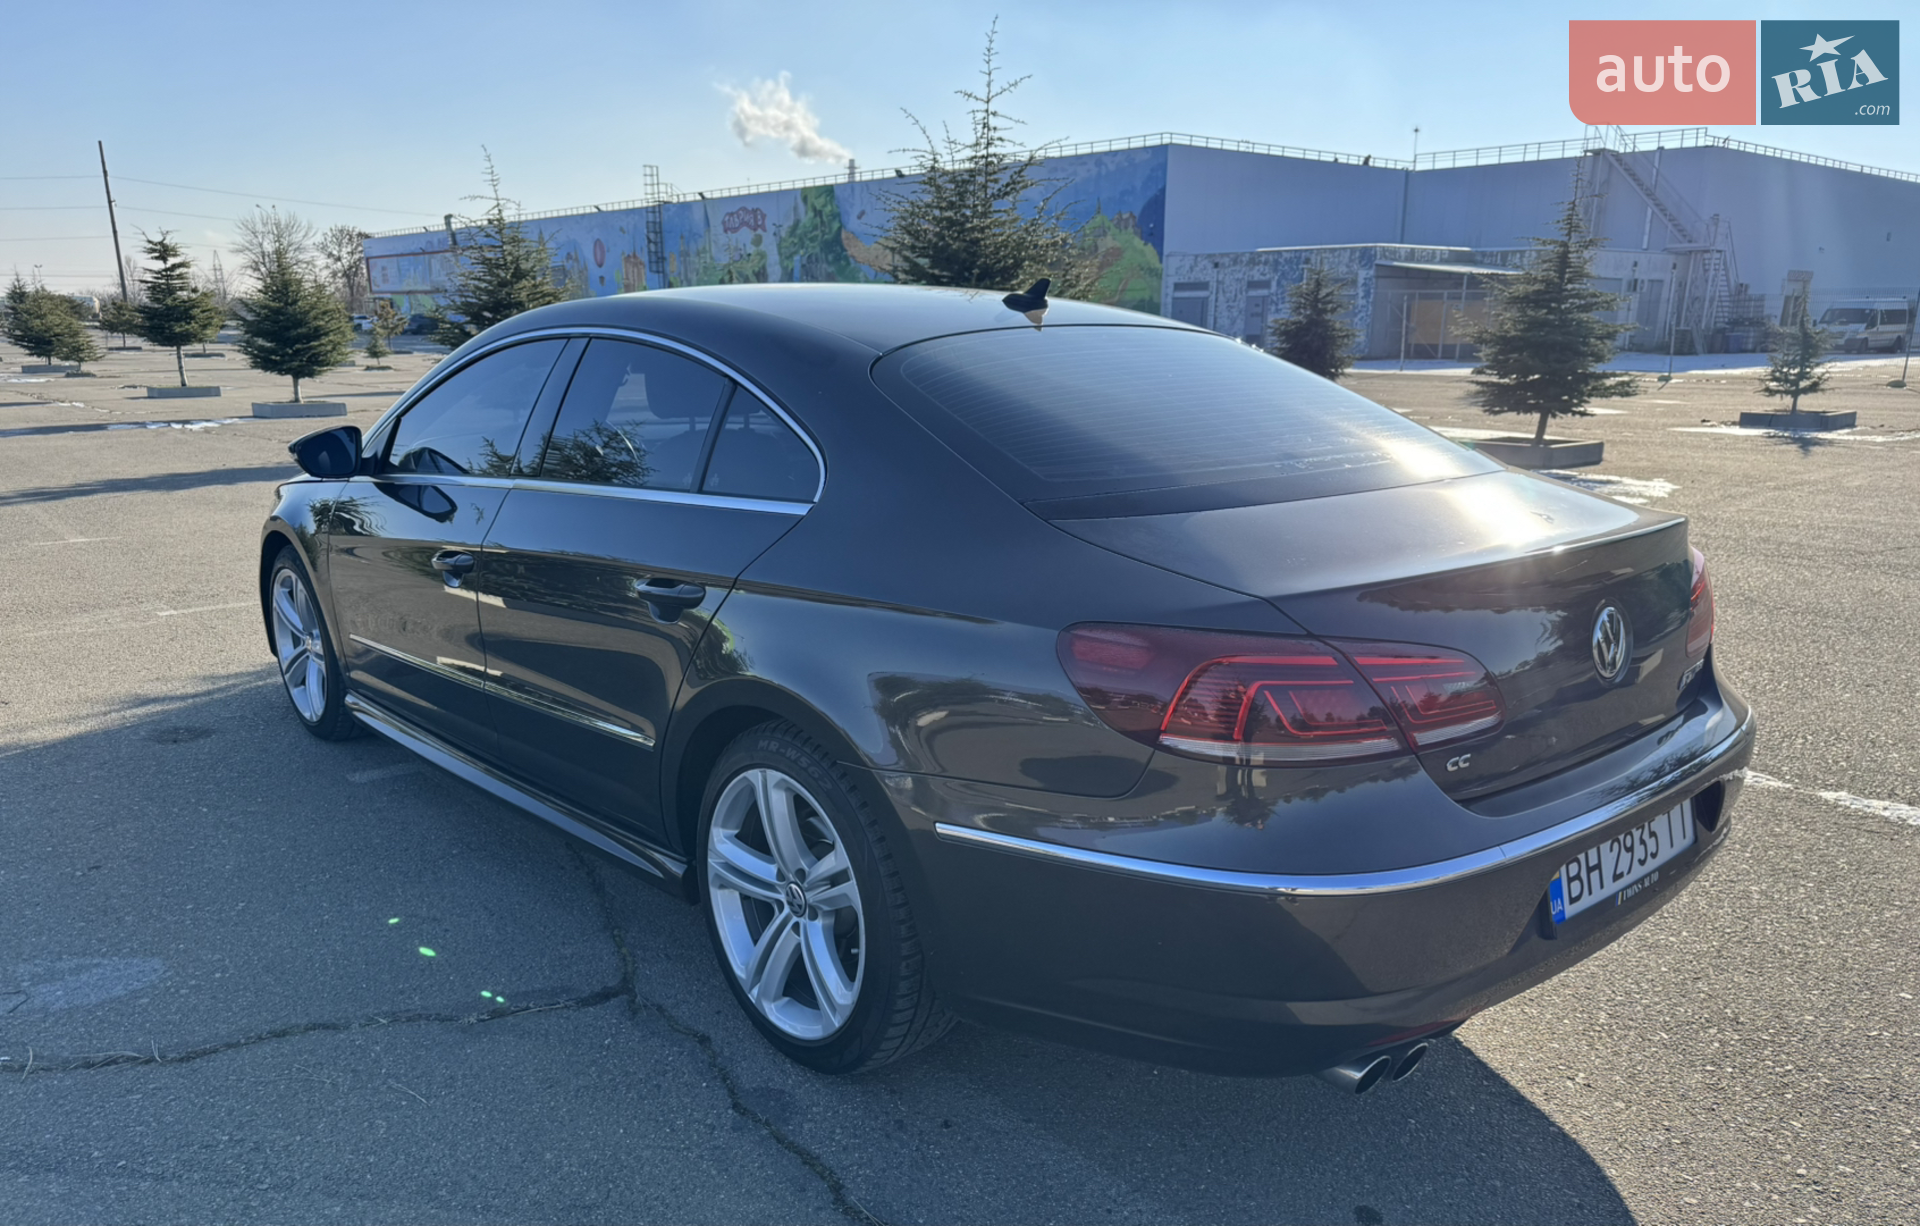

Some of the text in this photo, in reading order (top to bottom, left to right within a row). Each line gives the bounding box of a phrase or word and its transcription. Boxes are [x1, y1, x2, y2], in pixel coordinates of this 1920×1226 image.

[757, 739, 834, 791] MR-W562
[1446, 753, 1472, 772] CC
[1565, 846, 1605, 906] BH
[1610, 818, 1659, 883] 2935
[1550, 900, 1564, 915] UA
